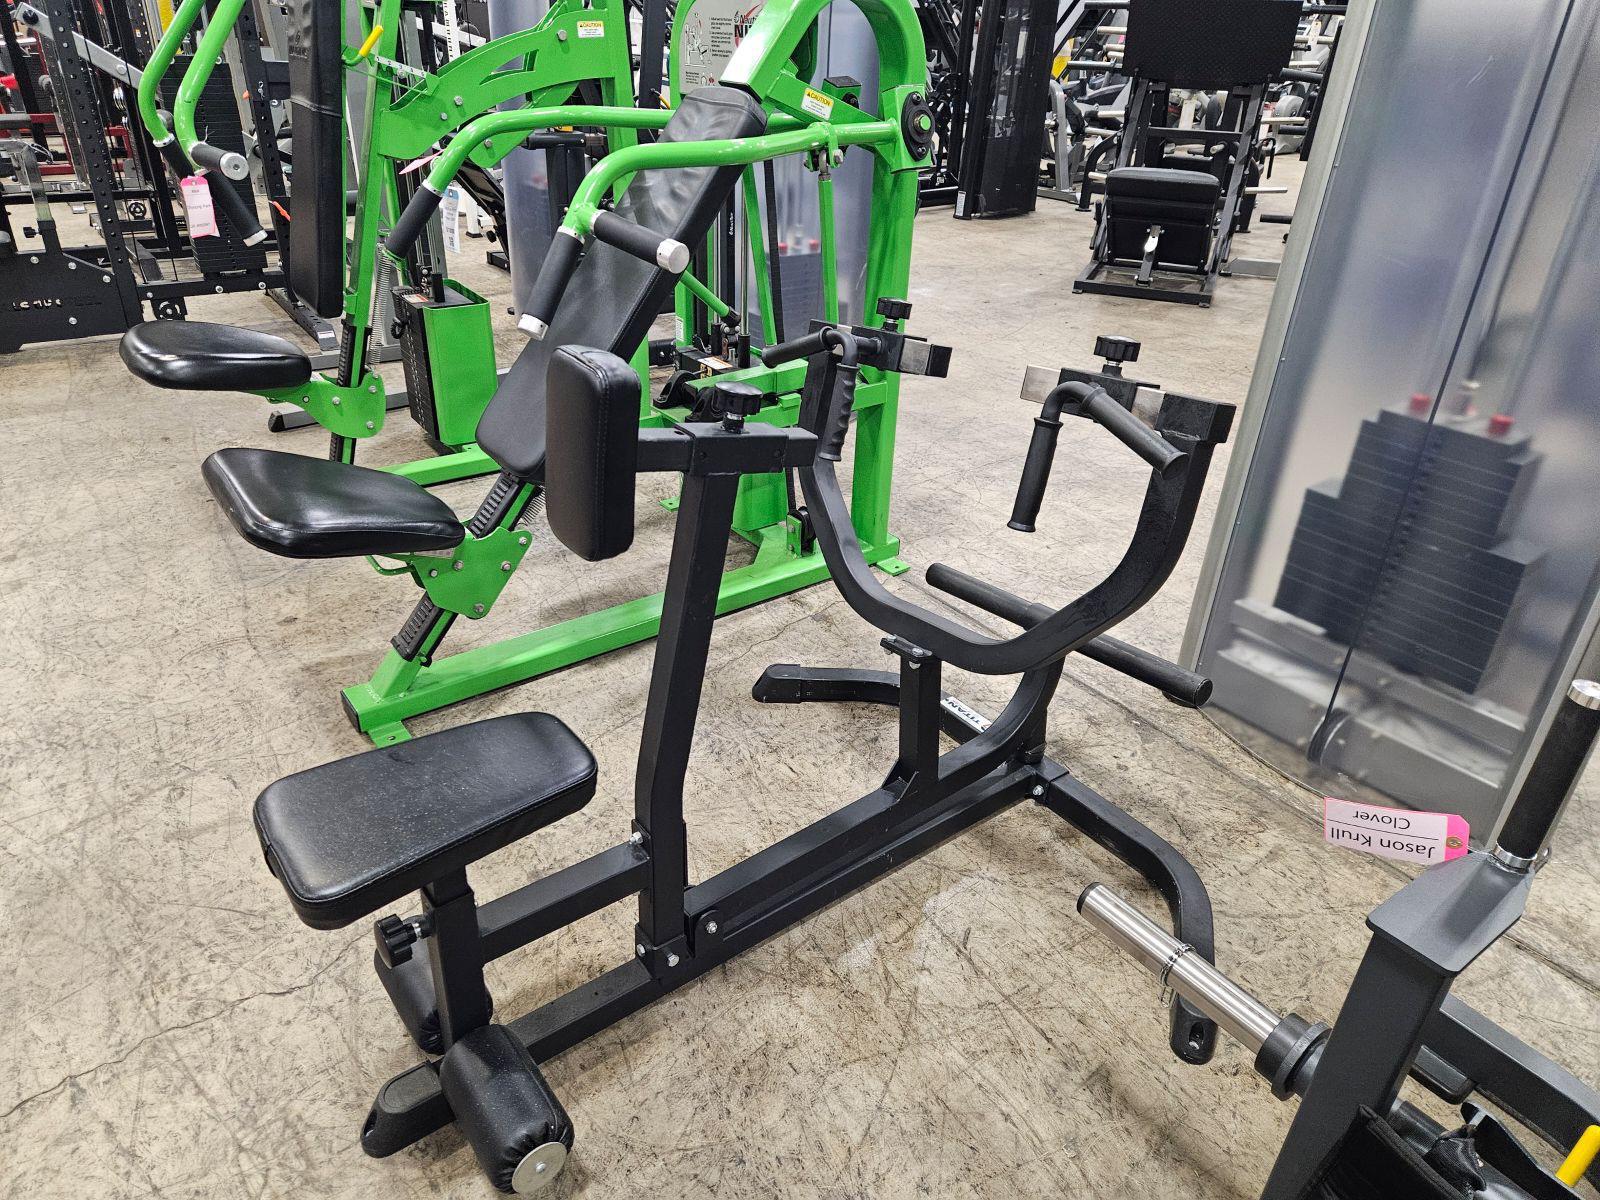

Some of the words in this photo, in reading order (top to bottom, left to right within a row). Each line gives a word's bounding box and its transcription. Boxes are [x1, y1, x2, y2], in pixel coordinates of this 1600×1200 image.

[810, 92, 831, 106] CAUTION
[947, 701, 981, 725] TITAN
[1352, 810, 1411, 830] Clover
[1331, 827, 1372, 847] Krull
[1380, 838, 1436, 859] Jason
